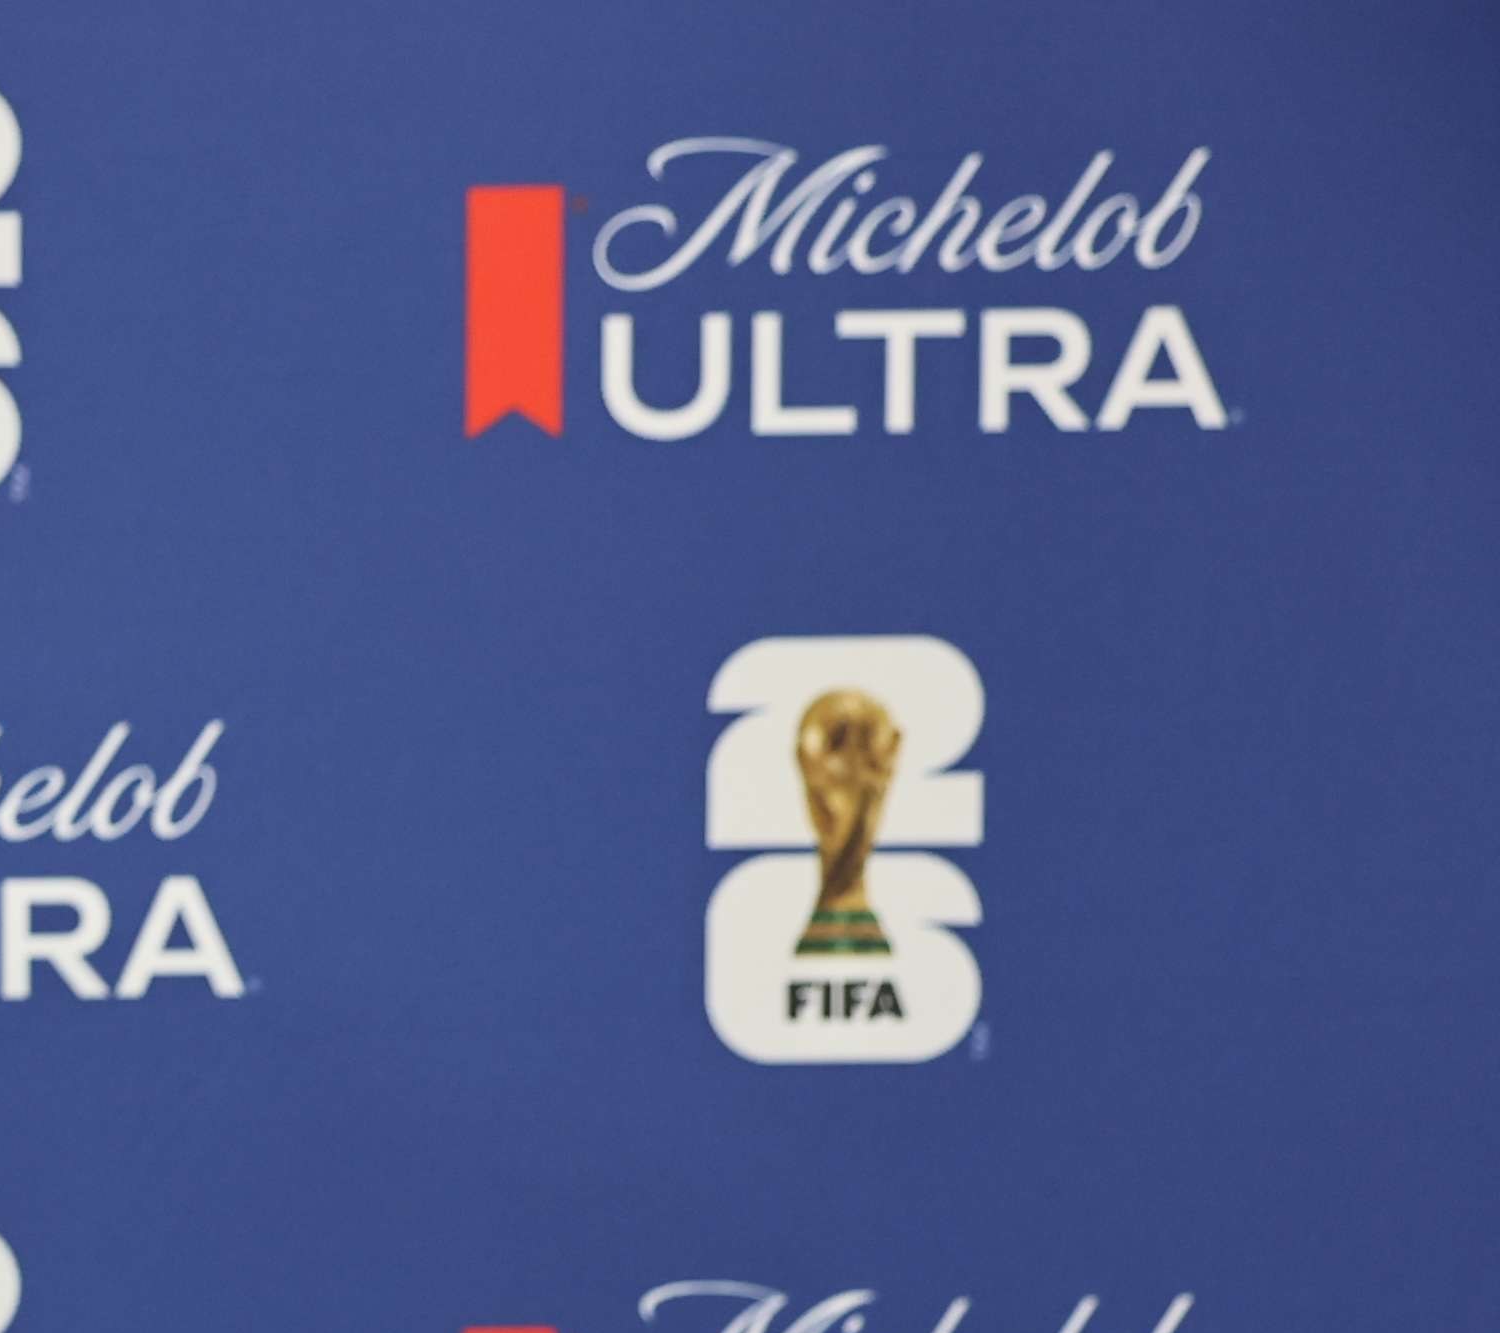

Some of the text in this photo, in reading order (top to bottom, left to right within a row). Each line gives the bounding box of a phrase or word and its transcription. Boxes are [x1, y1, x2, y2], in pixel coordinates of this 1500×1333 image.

[591, 136, 1210, 292] Michelob
[599, 304, 1228, 442] ULTRA
[786, 980, 904, 1021] FIFA
